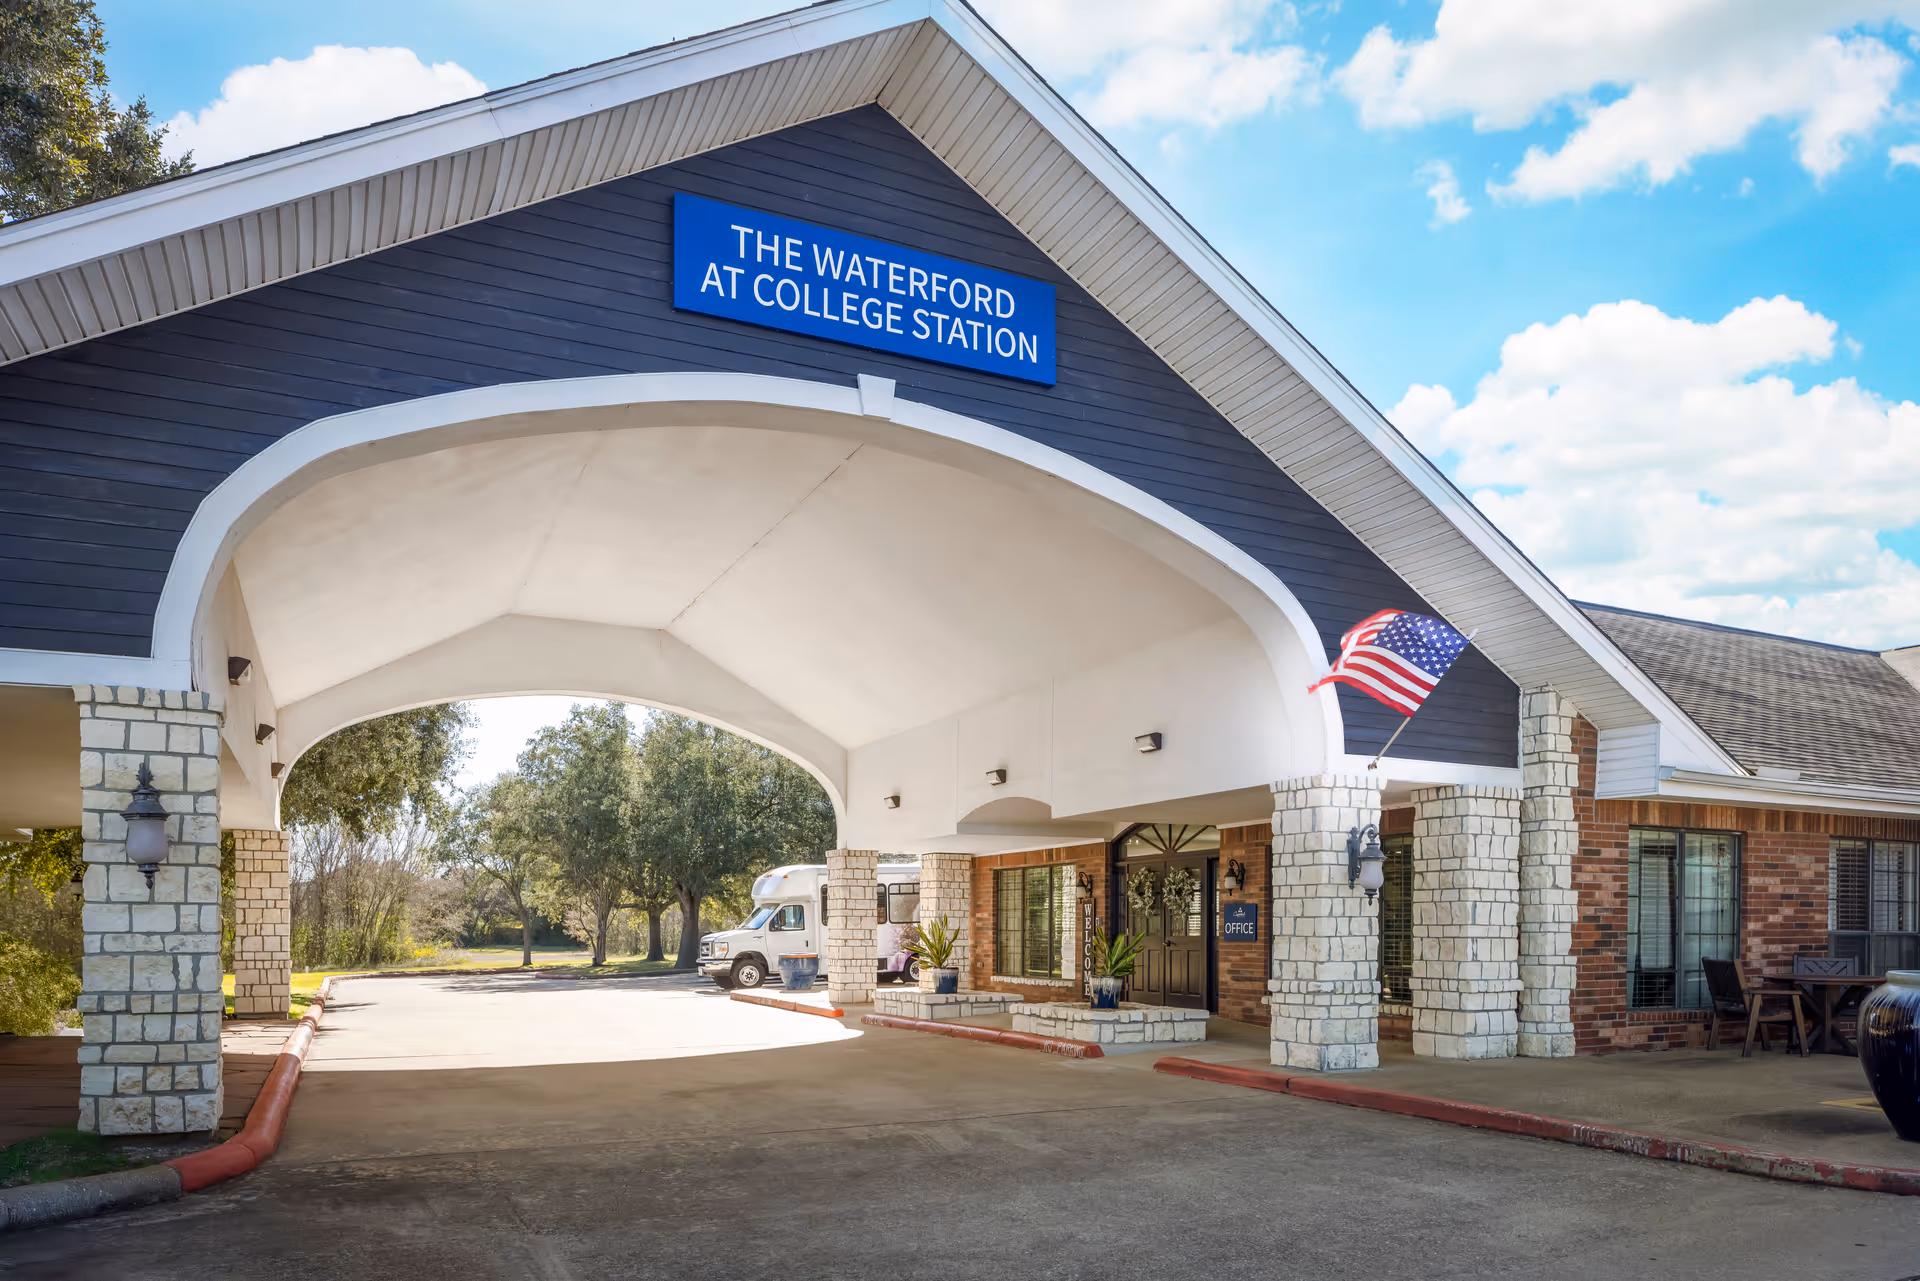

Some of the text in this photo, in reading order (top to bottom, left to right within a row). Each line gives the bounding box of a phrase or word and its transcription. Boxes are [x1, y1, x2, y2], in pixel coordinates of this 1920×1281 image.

[701, 262, 1037, 364] AT COLLEGE STATION
[731, 224, 1015, 318] THE WATERFORD
[1084, 903, 1092, 996] WELCOME
[1225, 922, 1254, 934] OFFICE
